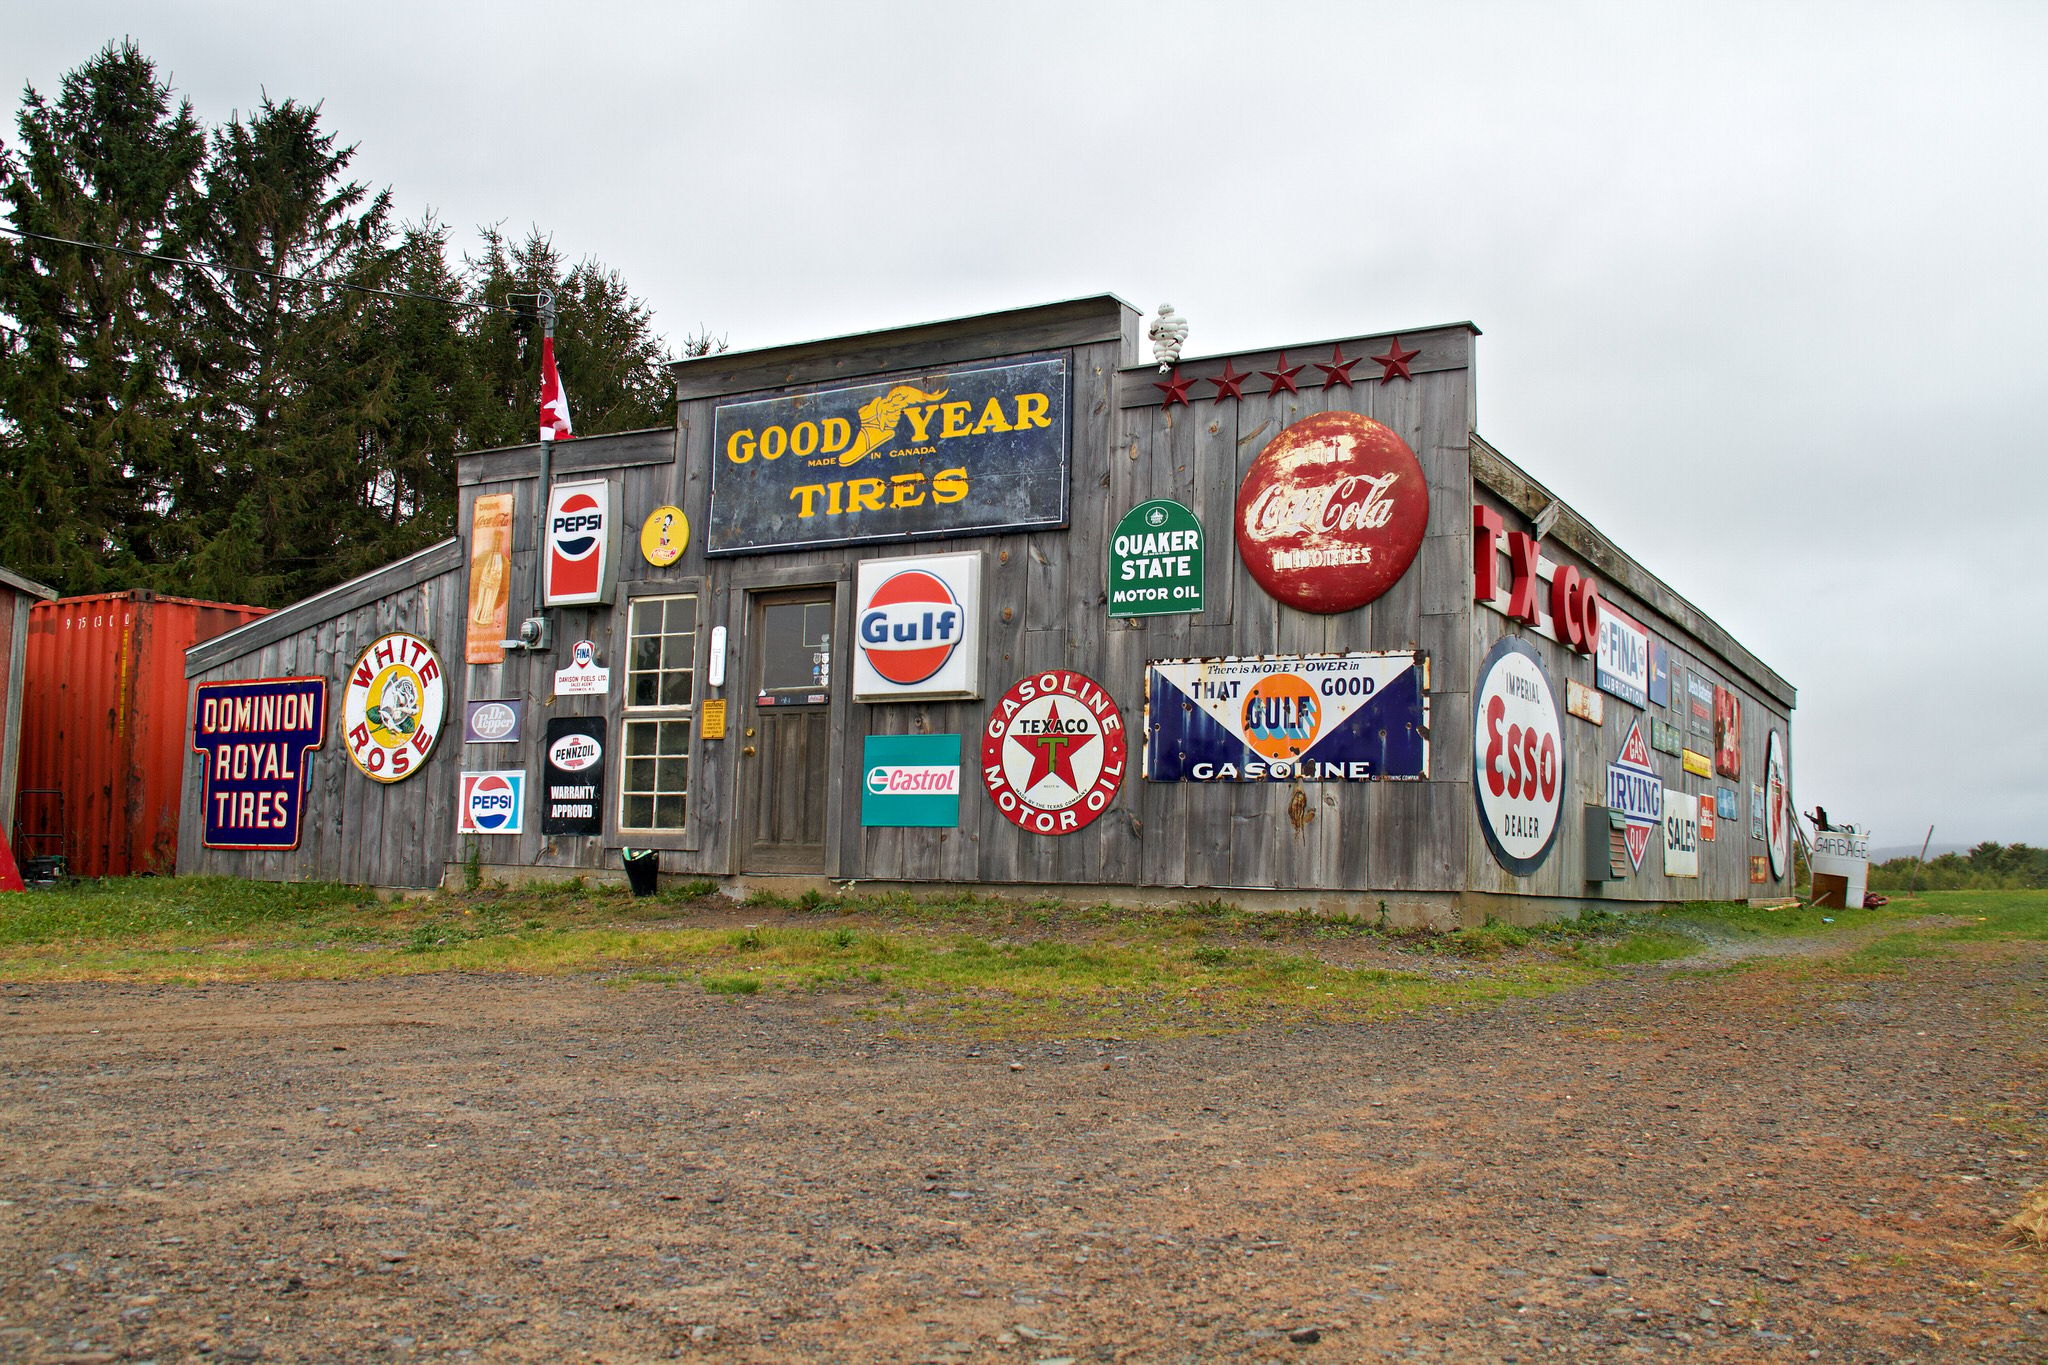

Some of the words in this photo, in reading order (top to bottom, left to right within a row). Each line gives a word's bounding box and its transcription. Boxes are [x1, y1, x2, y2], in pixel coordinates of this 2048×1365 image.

[727, 419, 852, 464] GOOD
[902, 392, 1052, 443] YEAR
[808, 457, 837, 467] MADE
[870, 451, 881, 460] IN
[889, 446, 937, 458] CANADA
[790, 467, 969, 518] TIRES
[553, 514, 602, 533] PEPSI
[1114, 530, 1199, 558] QUAKER
[1121, 556, 1191, 580] STATE
[1113, 588, 1169, 602] MOTOR
[1173, 586, 1200, 598] OIL
[861, 611, 956, 642] Gulf
[352, 638, 440, 688] WHITE
[576, 648, 590, 658] FINA
[1610, 621, 1638, 680] FINA
[1207, 665, 1238, 675] There
[1240, 664, 1249, 674] is
[1251, 663, 1290, 673] MORE
[1294, 661, 1348, 672] POWER
[1350, 661, 1360, 671] in
[1191, 680, 1241, 700] THAT
[1321, 677, 1375, 696] GOOD
[1506, 672, 1541, 705] IMPERIAL
[1602, 673, 1644, 706] LUBRICATION
[202, 693, 315, 734] DOMINION
[489, 706, 505, 720] Dr
[988, 674, 1121, 739] GASOLINE
[1249, 696, 1312, 733] GULF
[477, 713, 513, 734] Pepper
[1020, 719, 1088, 733] TEXACO
[349, 721, 433, 774] ROSE
[555, 744, 595, 761] PENNZOIL
[1037, 737, 1069, 772] T
[1629, 735, 1643, 762] GAS
[215, 742, 294, 781] ROYAL
[1192, 761, 1370, 779] GASOLINE
[551, 786, 595, 799] WARRANTY
[889, 769, 956, 791] Castrol
[1610, 771, 1660, 816] IRVING
[214, 791, 289, 828] TIRES
[472, 795, 512, 809] PEPSI
[985, 764, 1078, 832] MOTOR
[1087, 761, 1122, 811] OIL
[1015, 788, 1027, 800] MADE
[1065, 789, 1088, 807] COMPANY
[551, 804, 593, 818] APPROVED
[1504, 814, 1540, 839] DEALER
[1667, 816, 1696, 852] SALES
[1630, 827, 1644, 855] OIL
[1814, 837, 1867, 859] GARBAGE
